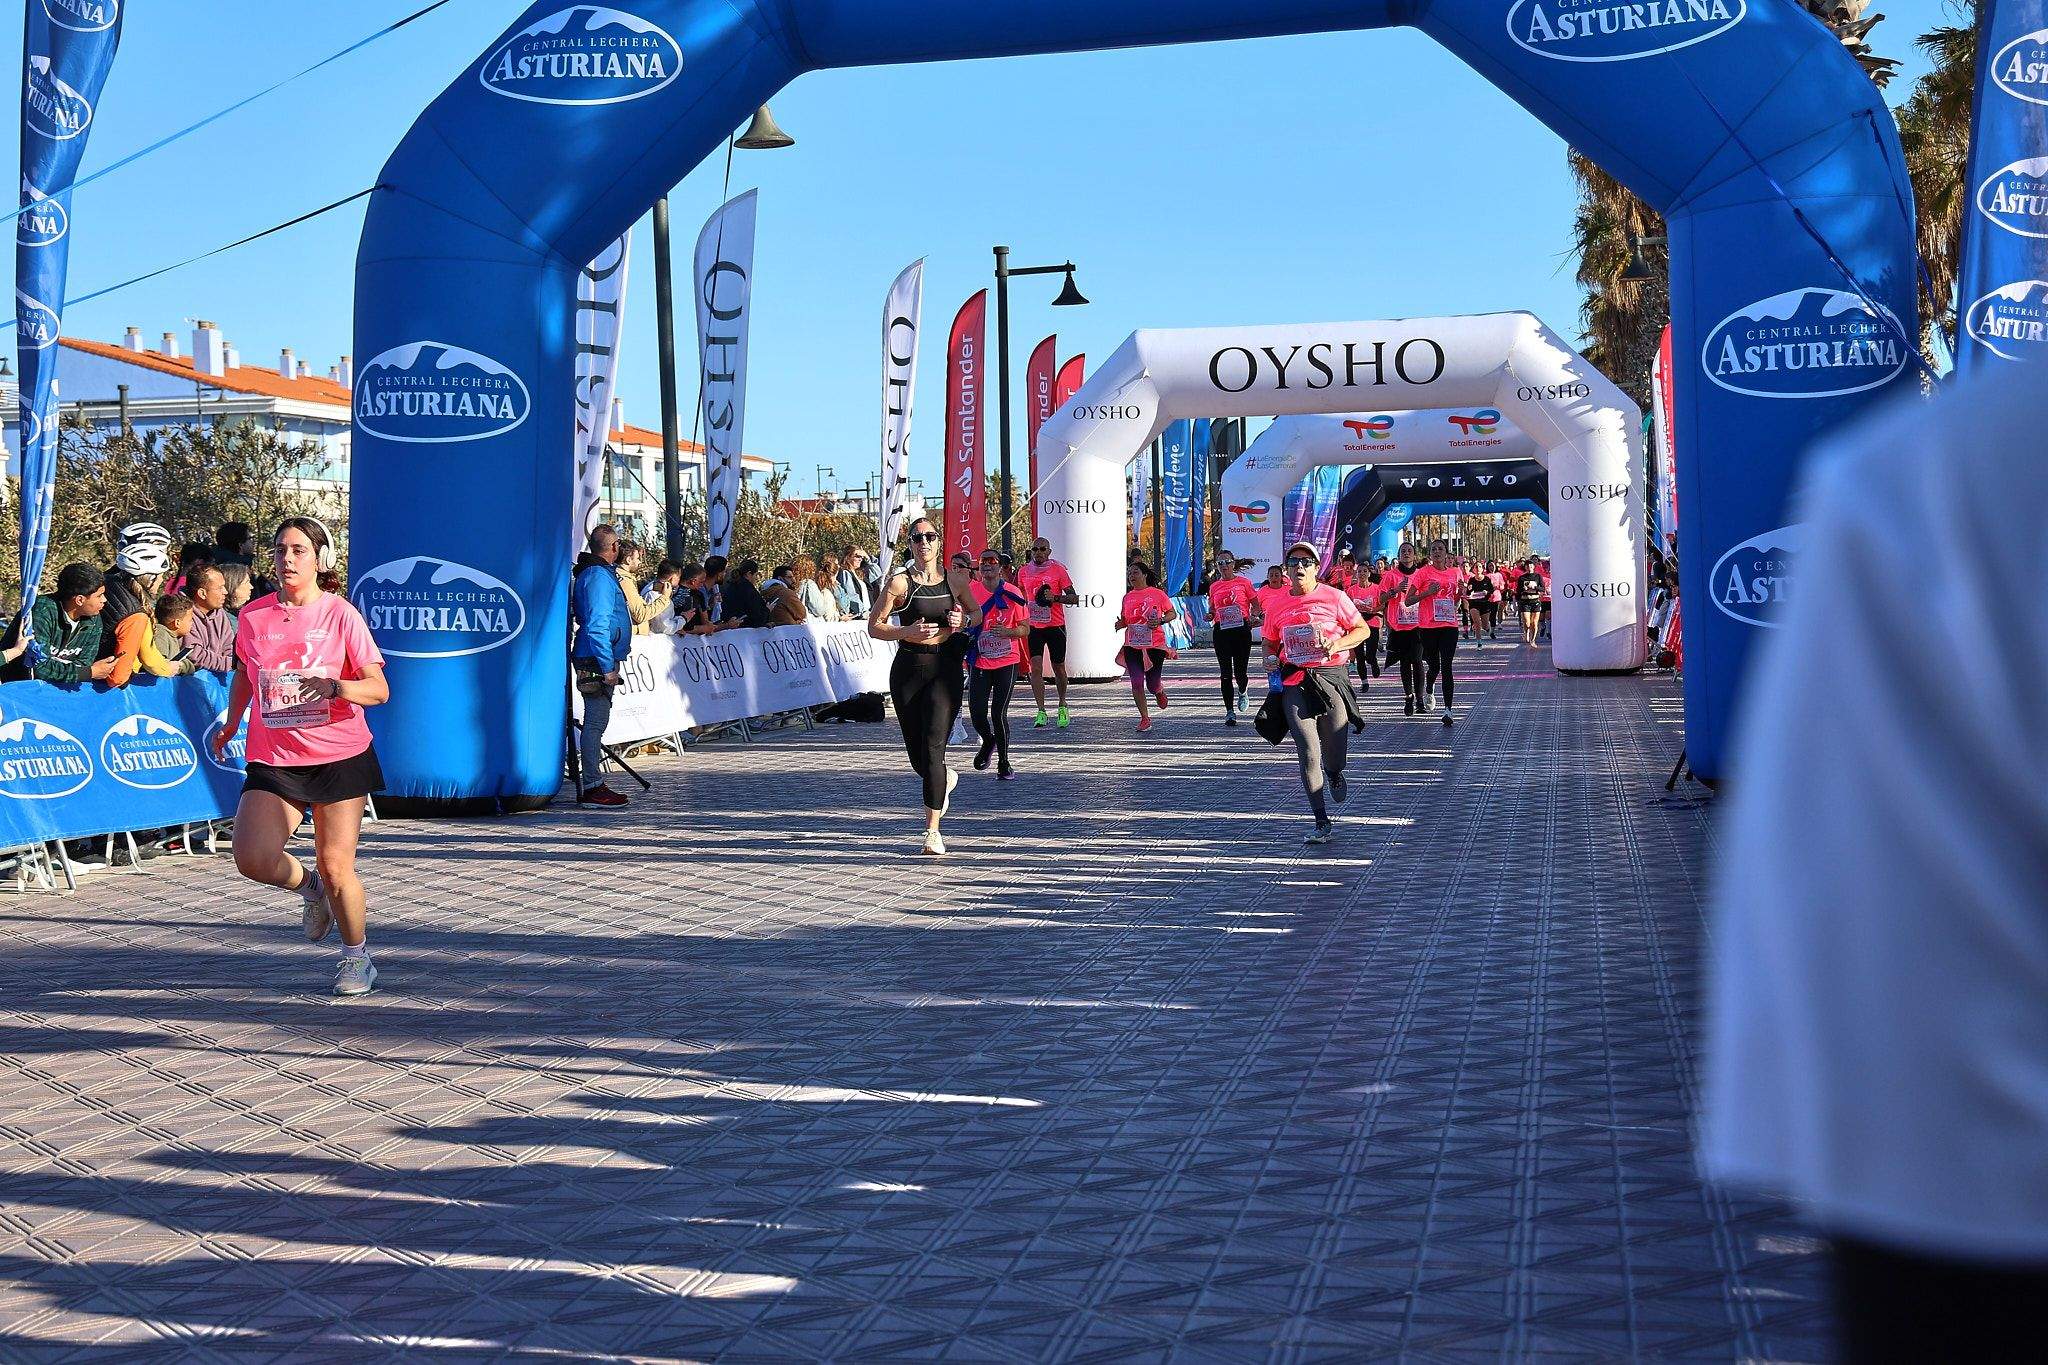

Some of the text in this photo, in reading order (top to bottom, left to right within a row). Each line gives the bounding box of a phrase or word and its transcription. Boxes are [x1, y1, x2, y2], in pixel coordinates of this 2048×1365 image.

[1527, 0, 1731, 42] ASTURIANA
[523, 37, 660, 52] CENTRAL LECHERA
[489, 49, 667, 82] ASTURIANA
[1999, 305, 2040, 317] CENTRAL
[1746, 323, 1890, 340] CENTRAL LECHER
[1716, 334, 1899, 376] ASTURIANA
[1208, 338, 1445, 392] OYSHO
[377, 376, 511, 389] CENTRAL LECHERA
[358, 380, 517, 419] ASTURIANA
[958, 333, 973, 463] Santander
[1517, 383, 1590, 401] OYSHO
[1073, 405, 1141, 420] OYSHO
[1343, 443, 1396, 452] TotalEnergies
[1449, 438, 1502, 448] TotalEnergies
[1165, 444, 1189, 519] Marlene
[1400, 475, 1517, 488] VOLVO
[1561, 484, 1628, 500] OYSHO
[1044, 500, 1106, 514] OYSHO
[1228, 526, 1271, 535] TotalEnergies
[1563, 582, 1631, 599] OYSHO
[1723, 564, 1797, 604] AST
[372, 590, 505, 603] CENTRAL LECHERA
[762, 636, 817, 674] OYSHO
[826, 629, 874, 666] OYSHO
[682, 643, 745, 683] OYSHO
[1, 743, 77, 756] CENTRAL LECHERA
[112, 743, 193, 773] ASTURIANA
